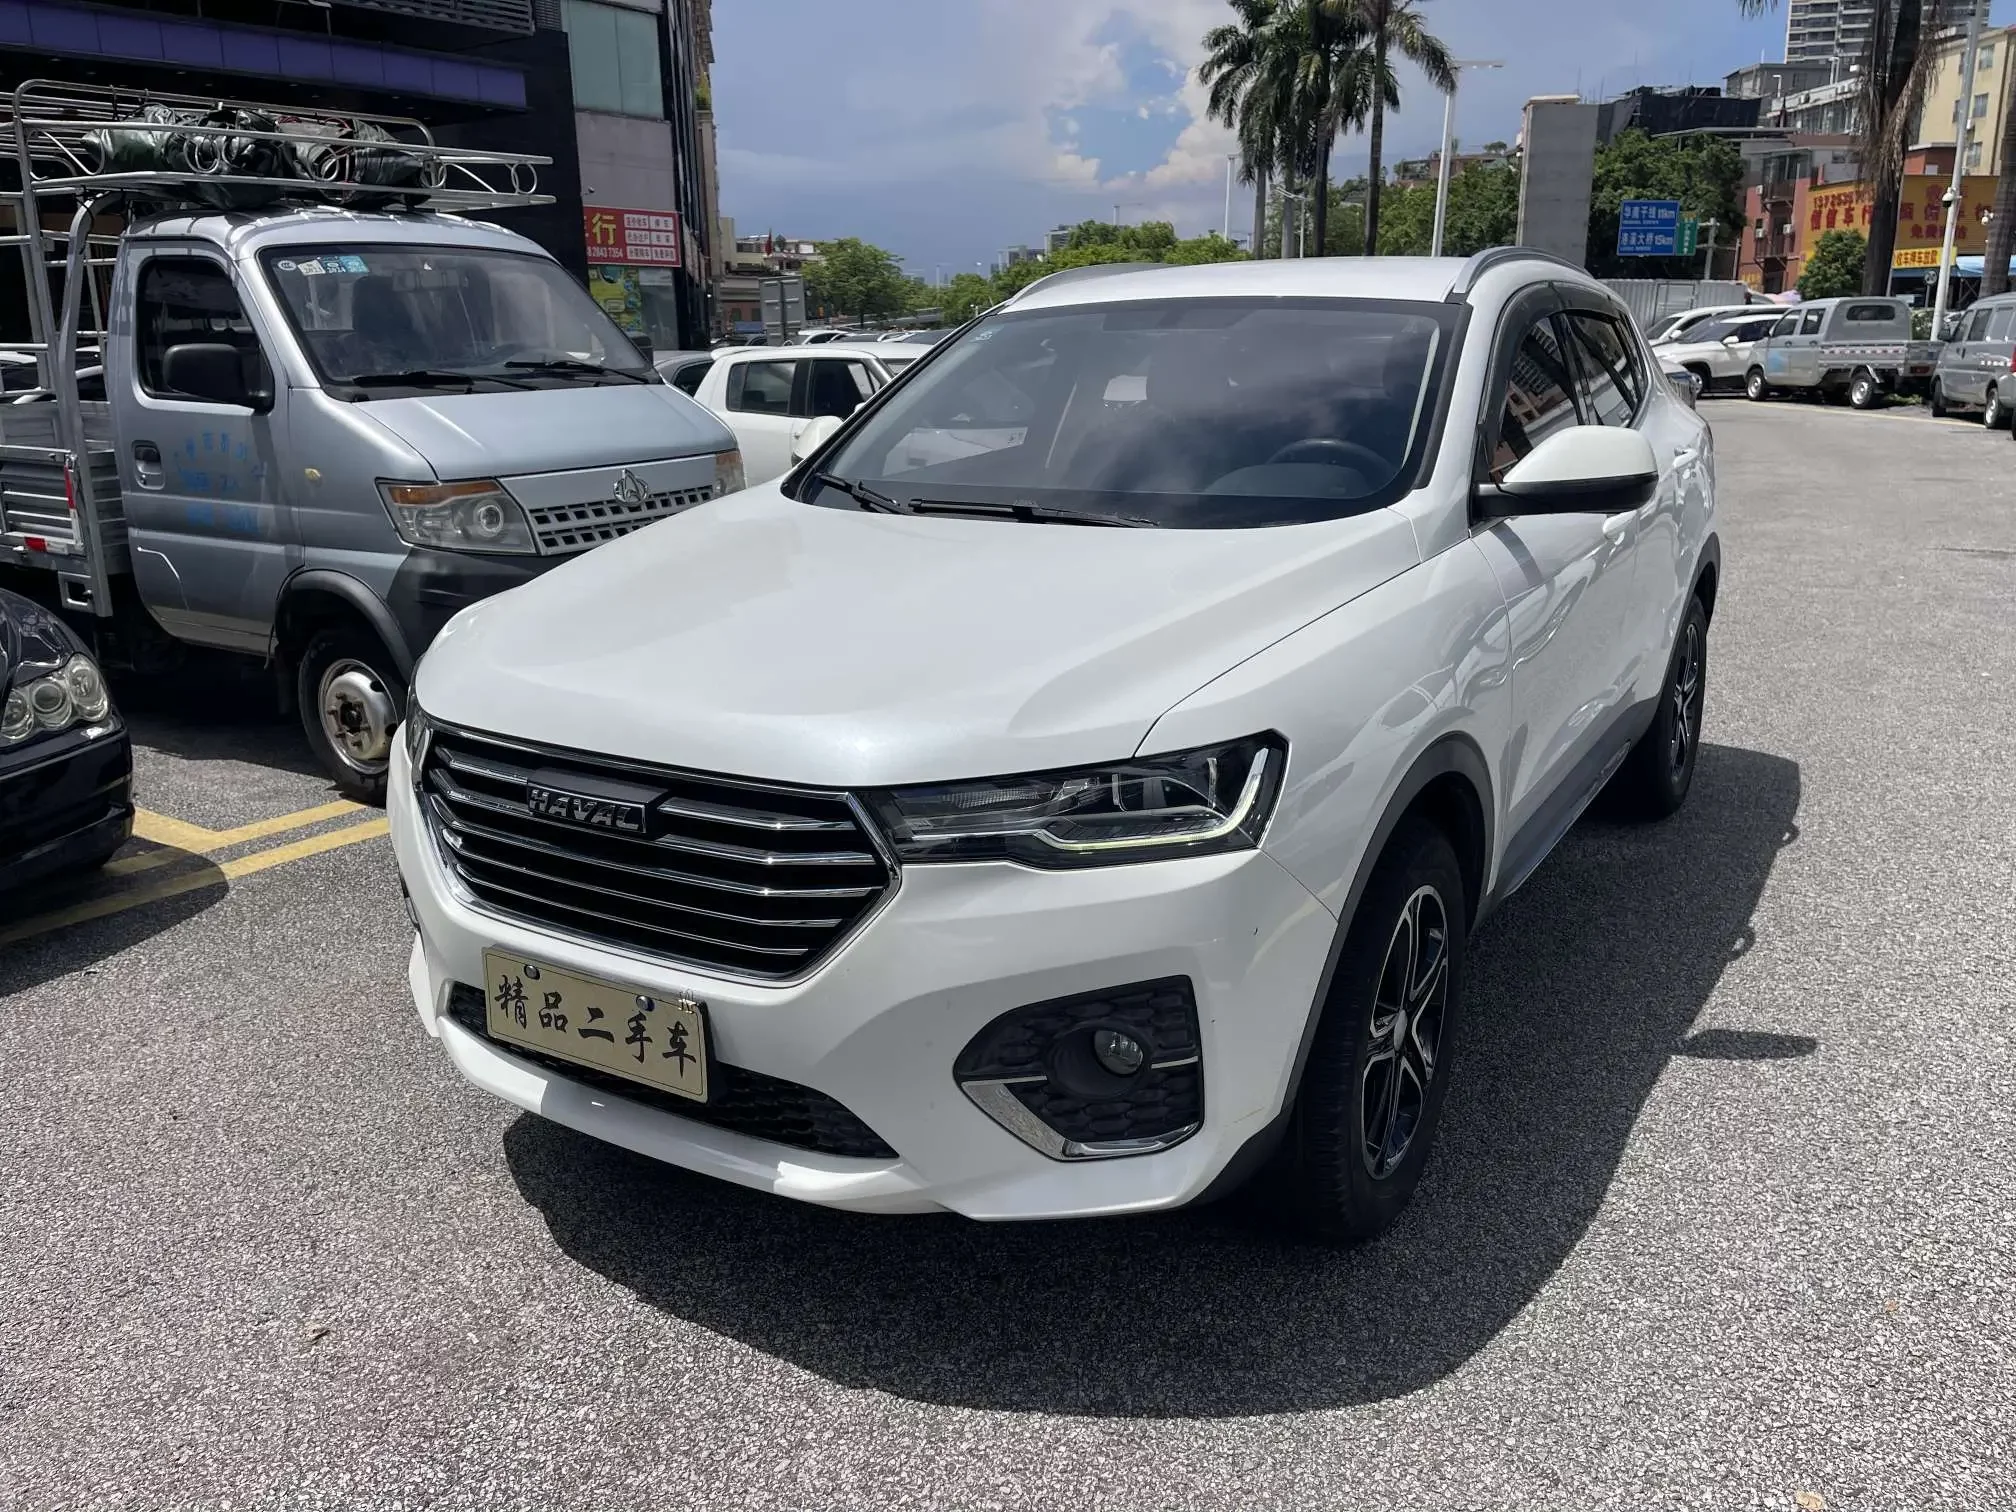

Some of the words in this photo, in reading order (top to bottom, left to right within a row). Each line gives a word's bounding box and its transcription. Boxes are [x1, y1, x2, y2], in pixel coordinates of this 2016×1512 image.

[529, 789, 639, 830] HAVAL
[494, 974, 698, 1078] 精品二手车
